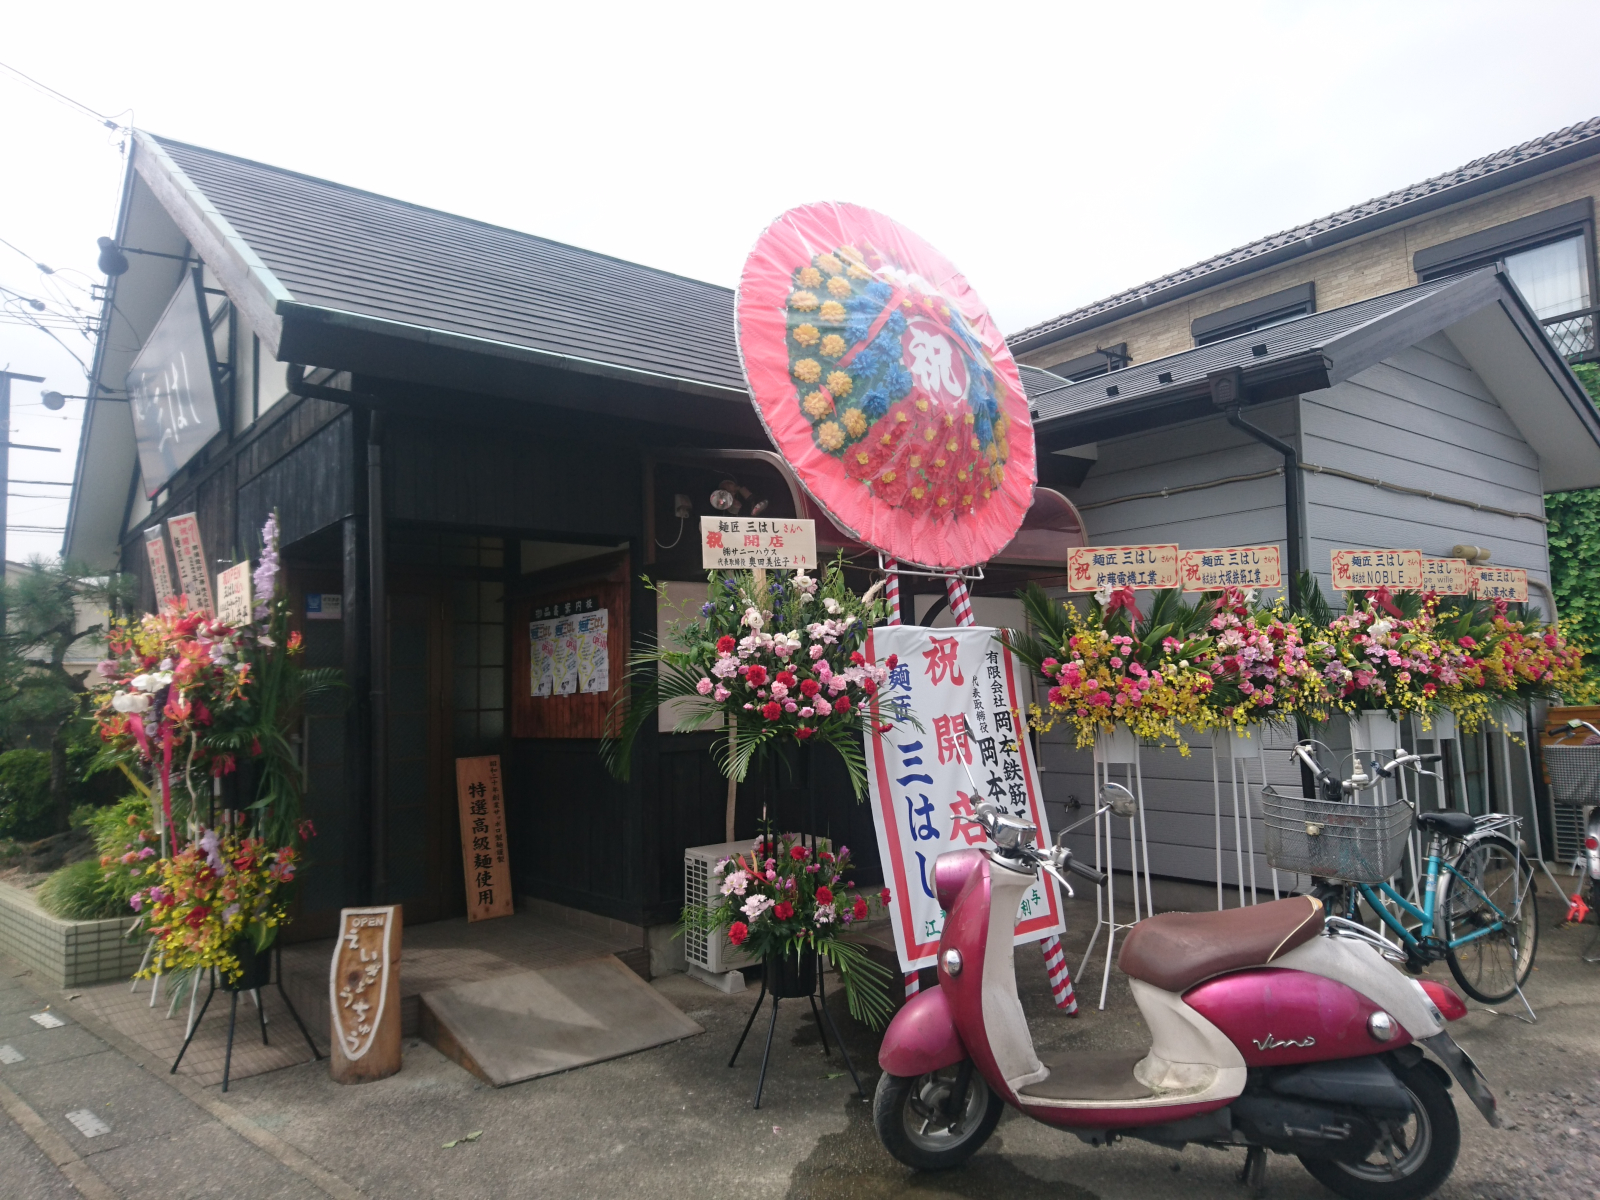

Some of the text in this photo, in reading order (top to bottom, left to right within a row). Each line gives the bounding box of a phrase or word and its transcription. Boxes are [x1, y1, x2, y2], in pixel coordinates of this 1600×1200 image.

[908, 325, 963, 397] 祝
[718, 520, 803, 534] 麺匠 三はし さんへ
[706, 531, 784, 548] 祝 開店
[793, 555, 806, 564] より
[1092, 550, 1175, 566] 麺匠 三はし さんへ
[1201, 555, 1225, 567] 麺匠
[1229, 551, 1260, 566] 三はし
[1351, 555, 1372, 567] 麺匠
[1376, 554, 1404, 566] 三はし
[1074, 562, 1091, 580] 祝
[1185, 563, 1201, 581] 祝
[1337, 563, 1351, 580] 祝
[1428, 562, 1451, 574] 三はし
[1096, 570, 1172, 587] 佐藤電機工業 より
[1264, 574, 1275, 582] より
[1367, 570, 1404, 584] NOBLE
[1408, 576, 1417, 584] より
[1496, 571, 1515, 582] 三はし
[972, 674, 989, 733] 代表取締役
[888, 663, 940, 899] 麺匠 三はし
[468, 782, 494, 906] 特選高級麺使用
[352, 917, 384, 927] OPEN
